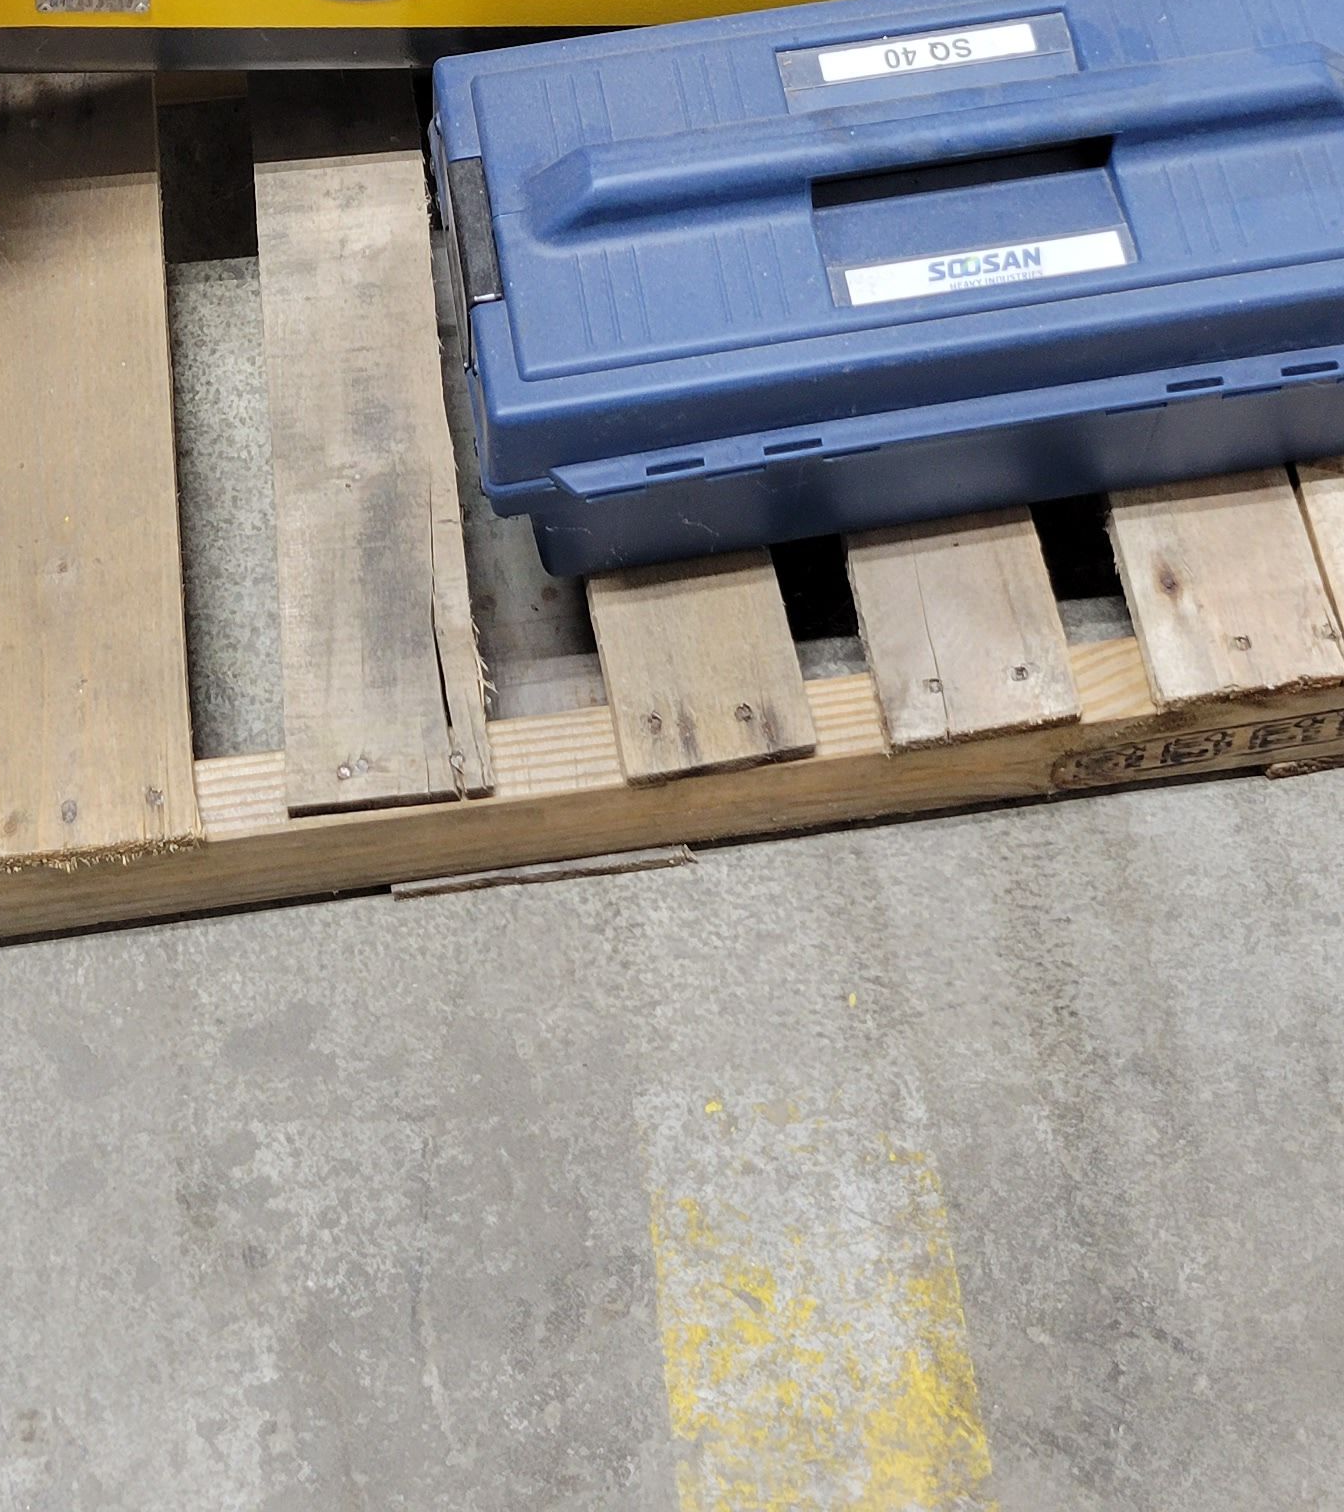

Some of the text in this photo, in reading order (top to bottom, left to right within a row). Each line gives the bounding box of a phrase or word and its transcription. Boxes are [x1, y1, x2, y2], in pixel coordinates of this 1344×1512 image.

[884, 38, 972, 69] SQ 40
[928, 247, 1042, 282] SOOSAN
